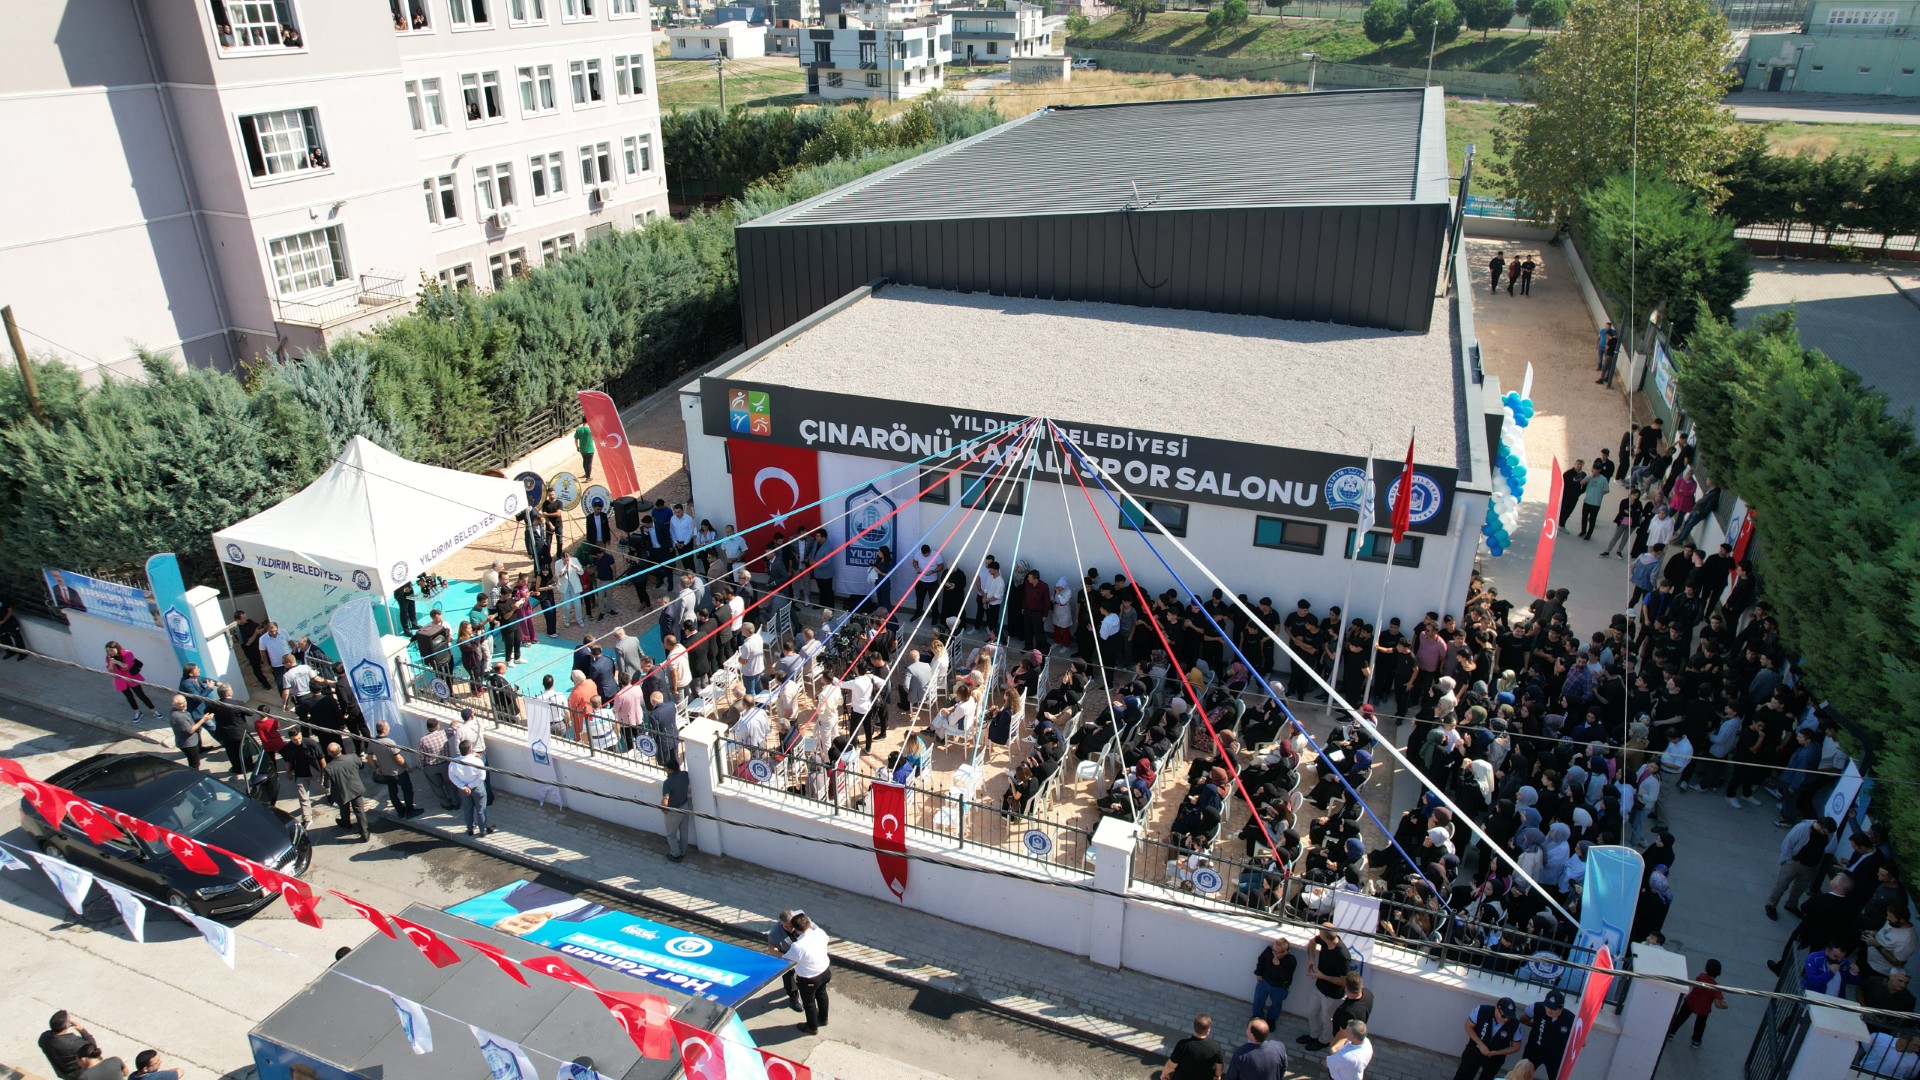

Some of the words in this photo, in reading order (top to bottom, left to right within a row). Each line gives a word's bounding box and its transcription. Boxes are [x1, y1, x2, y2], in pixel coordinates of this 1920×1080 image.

[951, 414, 1046, 440] YILDIRIM
[1054, 426, 1188, 458] BELEDİYESİ
[799, 418, 953, 459] ÇINARÖNÜ
[960, 440, 1072, 476] KAPALI
[1079, 455, 1171, 489] SPOR
[1174, 467, 1318, 507] SALONU
[420, 539, 453, 565] YILDIRIM
[454, 514, 496, 545] BELEDİYESİ
[256, 556, 290, 571] YILDIRIM
[561, 944, 658, 977] Zaman
[655, 972, 713, 992] Her
